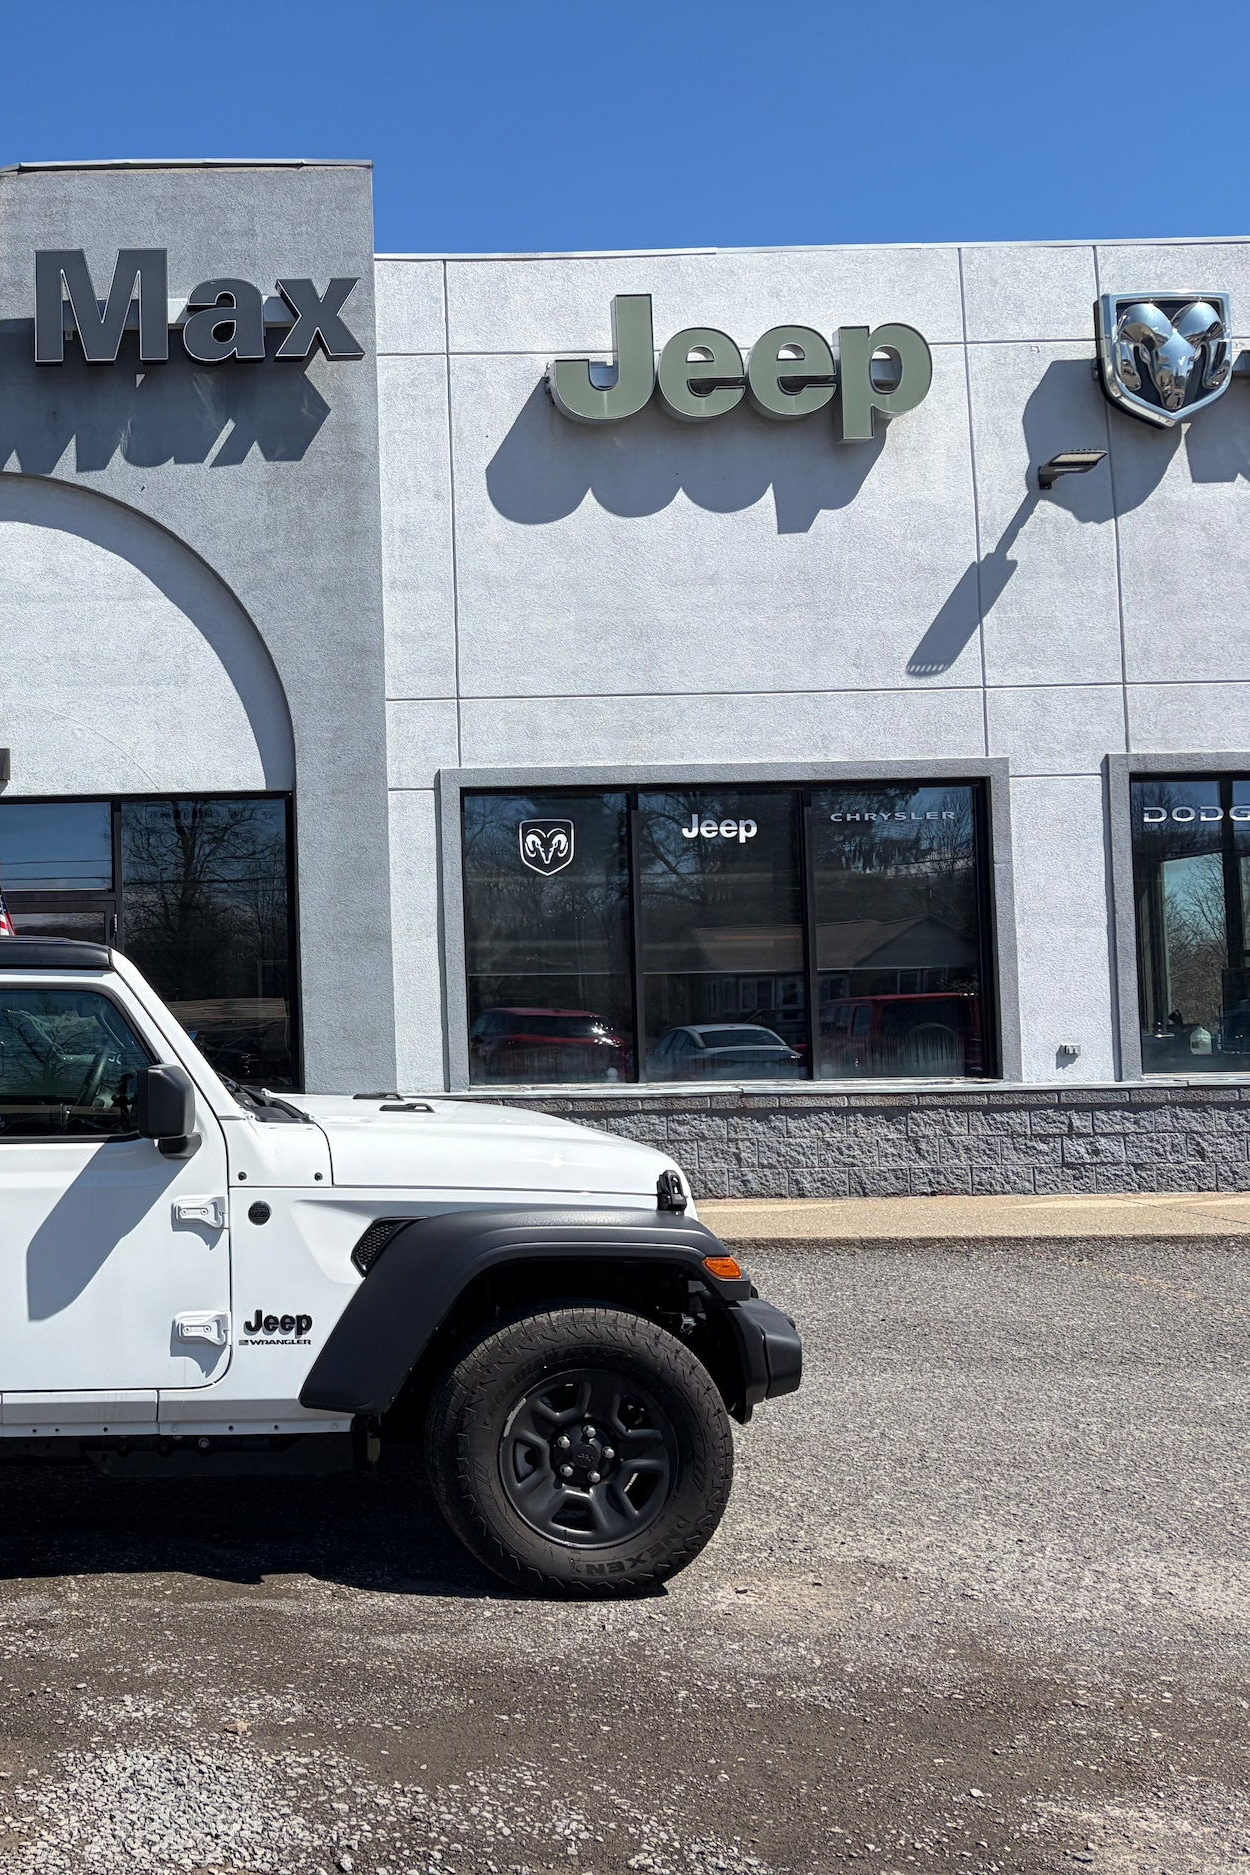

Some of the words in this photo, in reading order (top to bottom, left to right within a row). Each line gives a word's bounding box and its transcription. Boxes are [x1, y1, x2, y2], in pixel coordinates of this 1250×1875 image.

[34, 248, 365, 365] Max
[550, 294, 932, 443] Jeep
[682, 814, 757, 843] Jeep
[830, 811, 955, 822] CHRYSLER
[244, 1309, 312, 1336] Jeep
[585, 1528, 681, 1577] NEXEN
